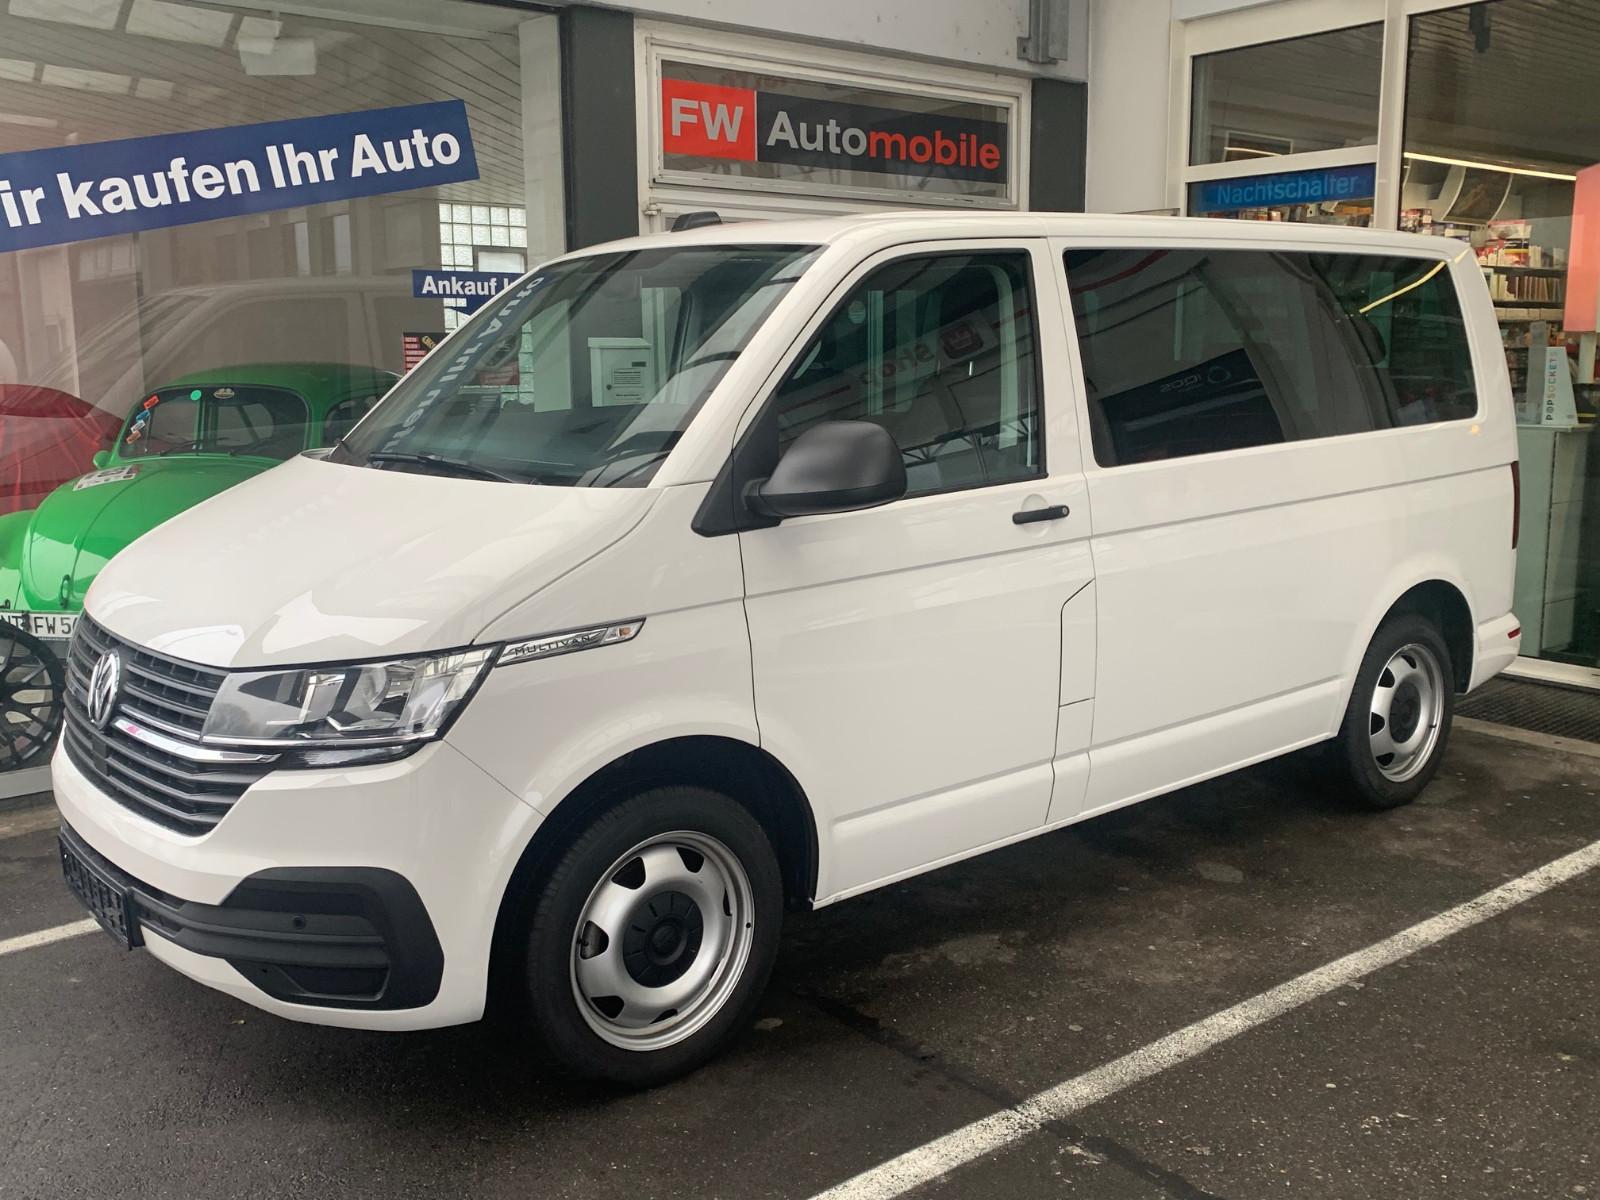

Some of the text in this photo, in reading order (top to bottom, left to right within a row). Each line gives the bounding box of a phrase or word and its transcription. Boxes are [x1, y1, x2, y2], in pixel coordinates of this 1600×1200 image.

[671, 97, 1001, 171] FW Automobile
[0, 127, 461, 228] ir kaufen Ihr Auto
[1216, 172, 1359, 205] Nachtschalter
[421, 274, 498, 296] Ankauf
[33, 616, 57, 635] FW
[514, 635, 592, 656] MULTIVAN
